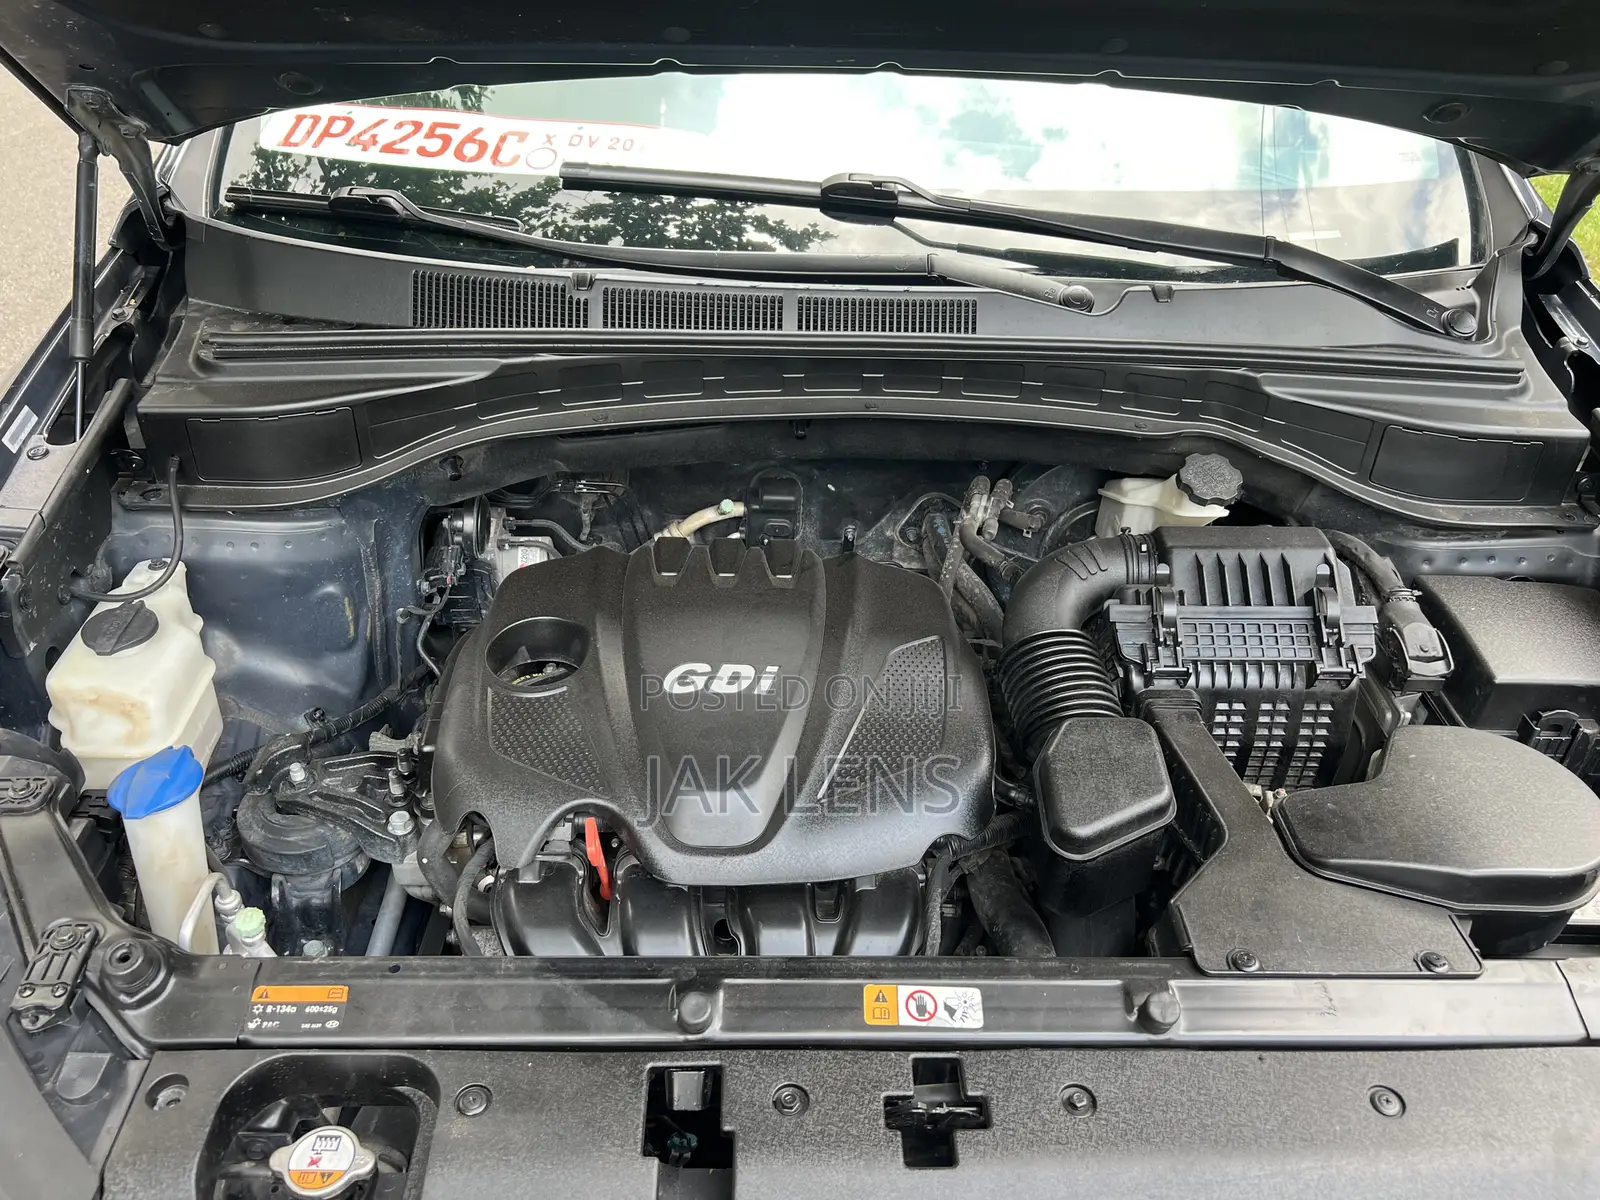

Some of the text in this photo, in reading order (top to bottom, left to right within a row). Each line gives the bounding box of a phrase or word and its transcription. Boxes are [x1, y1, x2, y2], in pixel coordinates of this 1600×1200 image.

[276, 114, 530, 168] DP4256C
[663, 663, 781, 695] GDi
[266, 1004, 298, 1014] R-134a
